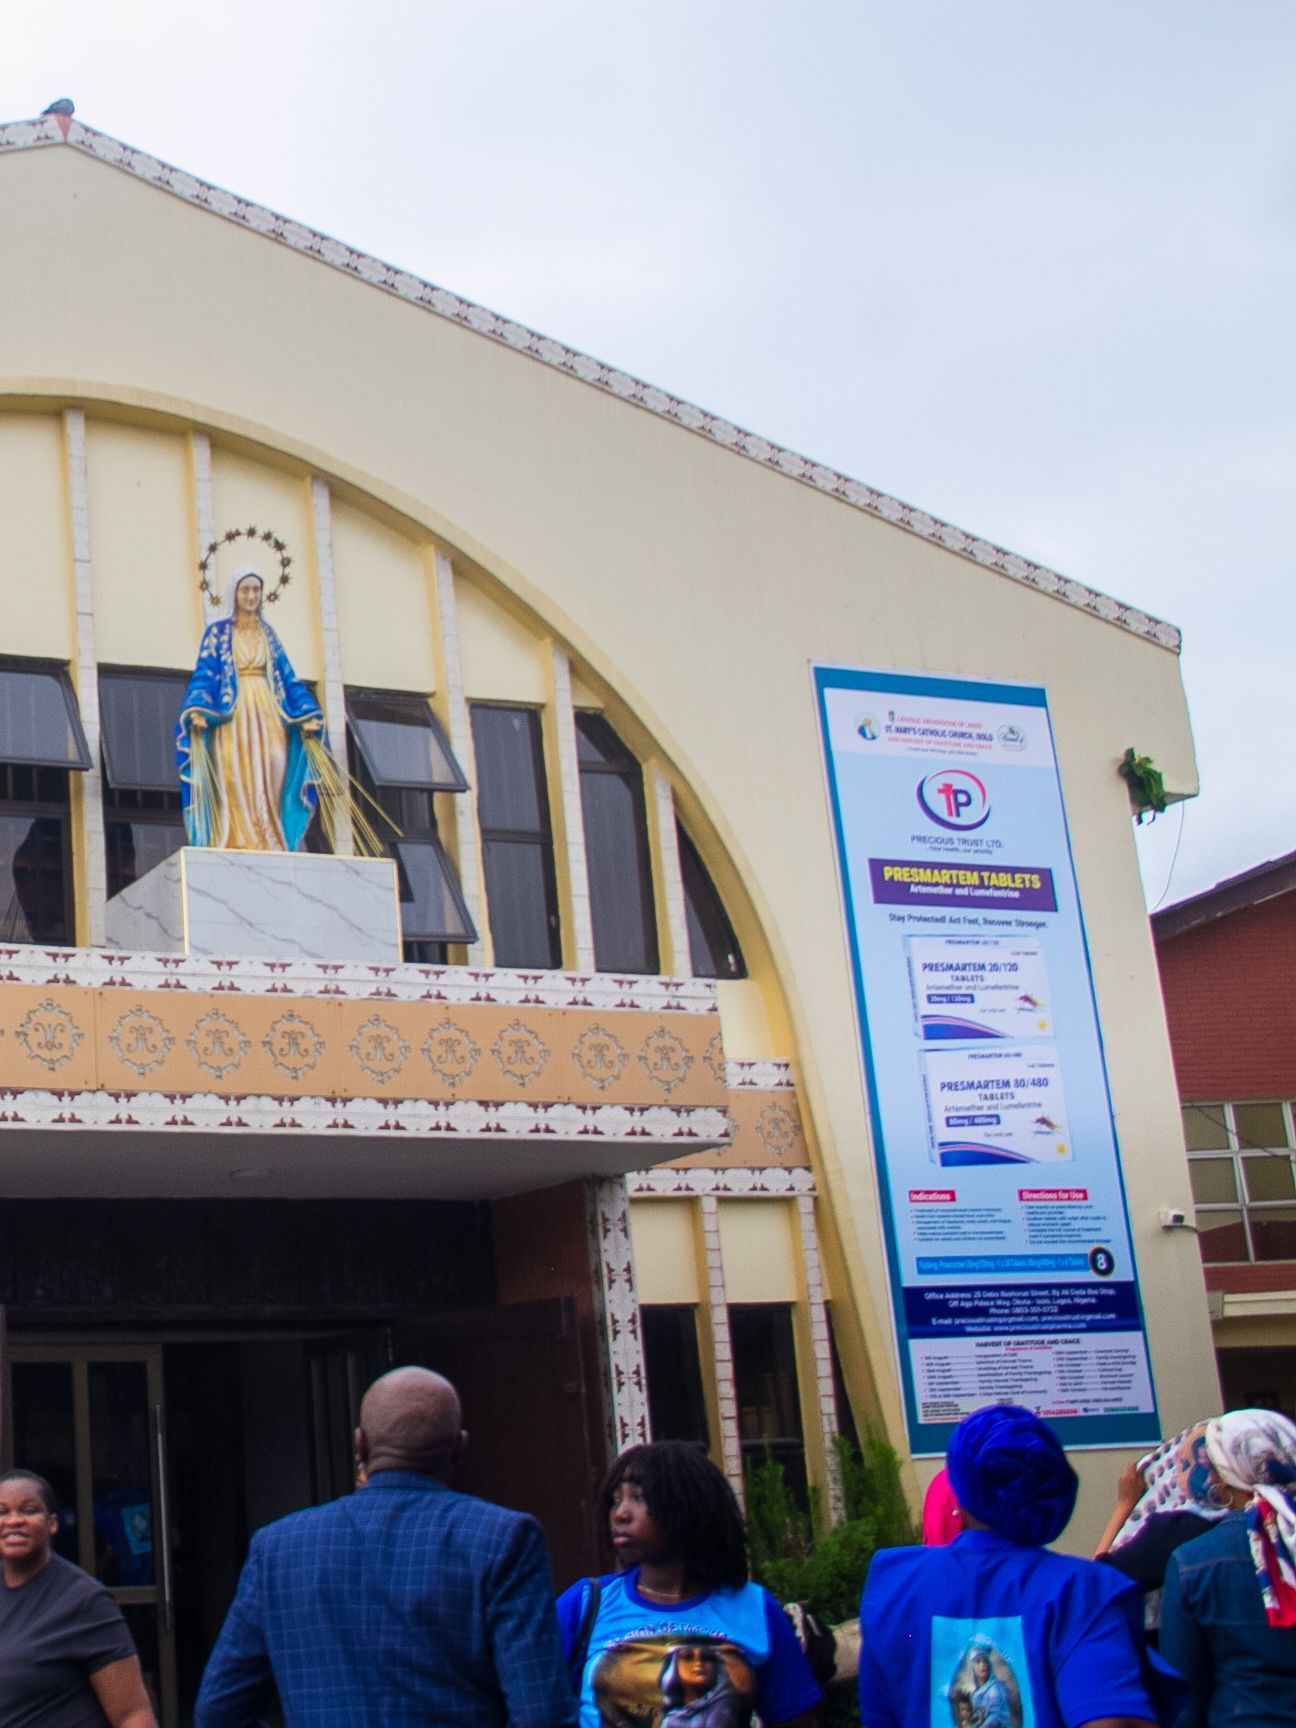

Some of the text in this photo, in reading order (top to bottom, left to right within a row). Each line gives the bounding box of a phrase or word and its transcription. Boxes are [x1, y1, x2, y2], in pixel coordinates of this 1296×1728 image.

[918, 728, 946, 738] CATHOLIC
[910, 834, 954, 846] PRECIOUS
[956, 837, 984, 848] TRUST
[883, 866, 1042, 889] PRESMARTEM TABLETS
[909, 884, 1020, 898] Artemether and Lumefantrine
[888, 913, 905, 924] Stay
[948, 914, 961, 924] Act
[982, 917, 1012, 927] Recover
[922, 962, 1018, 973] PRESMARTEM 20/120
[950, 975, 984, 983] TABLETS
[940, 1077, 1049, 1092] PRESMARTEM 80/480
[977, 1092, 1015, 1101] TABLETS
[943, 1103, 984, 1113] Artemether
[986, 1103, 999, 1111] and
[911, 1191, 951, 1201] Indications
[1022, 1190, 1084, 1200] Directions for Use
[975, 1340, 1002, 1348] HARVEST
